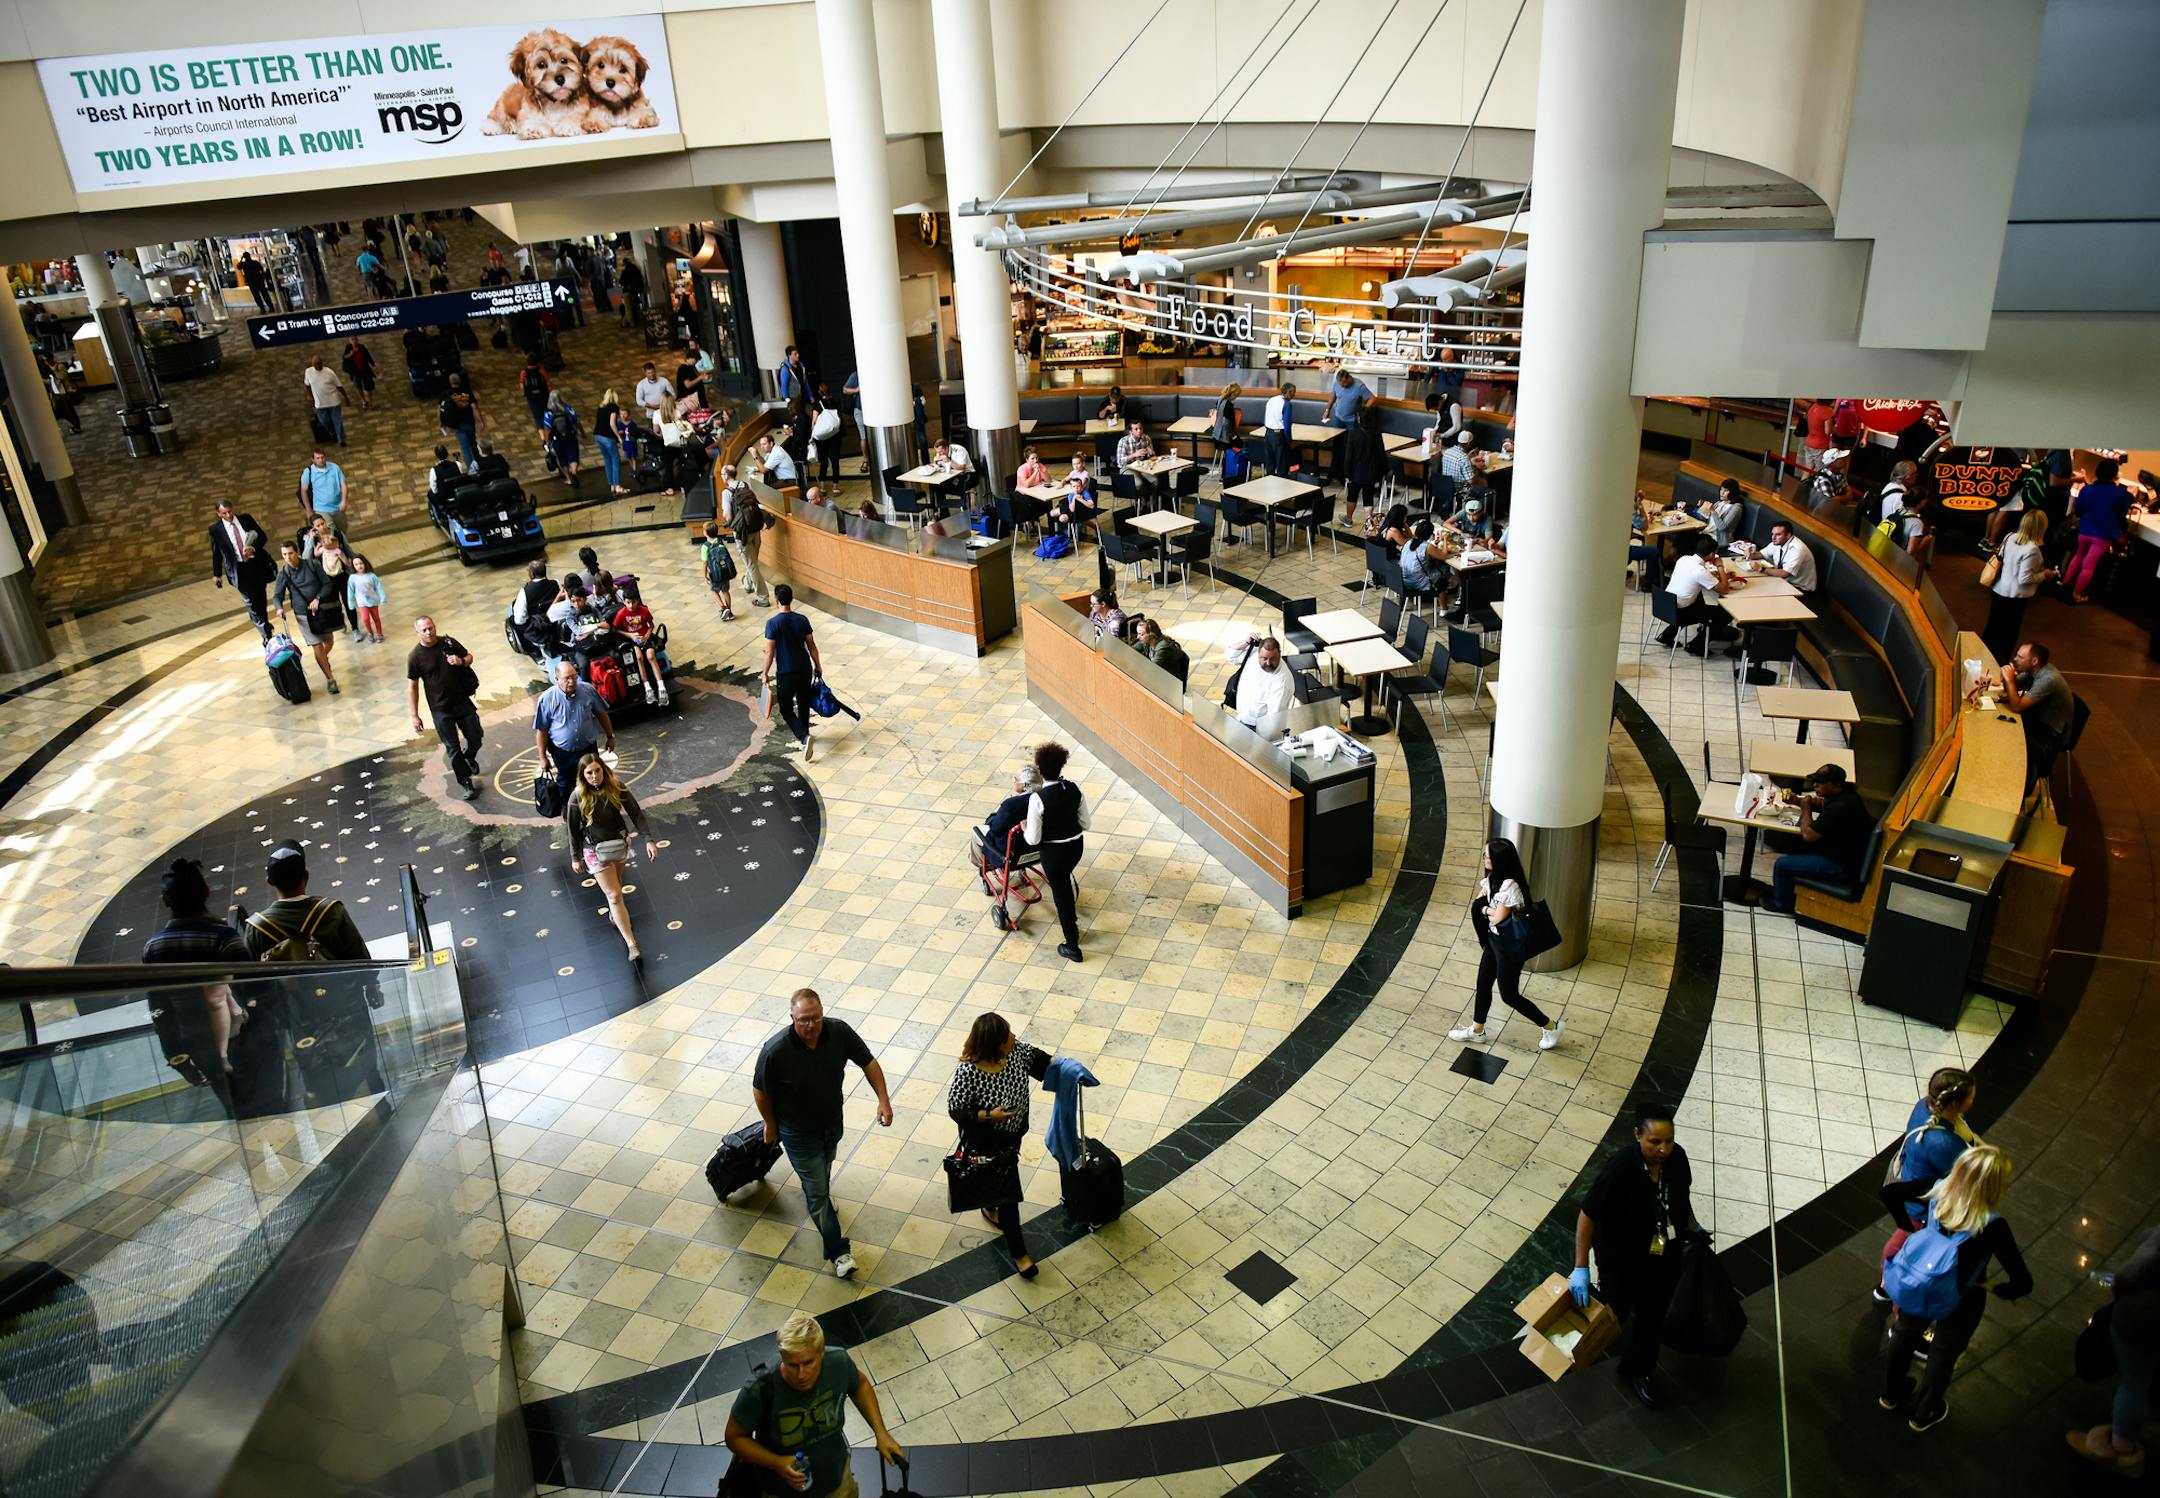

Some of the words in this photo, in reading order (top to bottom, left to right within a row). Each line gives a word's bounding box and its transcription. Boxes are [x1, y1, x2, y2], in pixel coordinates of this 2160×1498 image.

[70, 66, 141, 99] TWO
[149, 63, 180, 93] IS
[187, 54, 300, 90] BETTER
[305, 47, 384, 80] THAN
[390, 42, 452, 73] ONE.
[374, 90, 416, 100] Minneapolis
[420, 88, 439, 97] Saint
[439, 86, 454, 95] Paul
[375, 98, 426, 106] INTERNATIONAL
[132, 99, 193, 120] Airport
[196, 97, 214, 114] in
[217, 93, 265, 112] North
[153, 123, 194, 138] Airports
[195, 119, 233, 133] Council
[236, 115, 298, 130] International
[377, 101, 463, 136] msp
[94, 148, 151, 173] TWO
[155, 140, 239, 167] YEARS
[243, 136, 271, 159] IN
[278, 134, 296, 157] A
[299, 128, 364, 155] ROW!
[471, 288, 514, 300] Concourse
[491, 297, 514, 306] Gates
[514, 292, 542, 303] C1-C12
[490, 305, 523, 316] Baggage
[523, 300, 544, 310] Claim
[288, 319, 310, 329] Tram
[310, 318, 322, 327] to:
[334, 310, 380, 322] Concourse
[336, 322, 360, 332] Gates
[360, 317, 396, 328] C22-C28
[1167, 294, 1255, 342] Food
[1289, 308, 1436, 360] Court
[1935, 463, 2022, 481] DUNN
[1939, 479, 2011, 497] BROS
[1948, 498, 1991, 506] COFFEE
